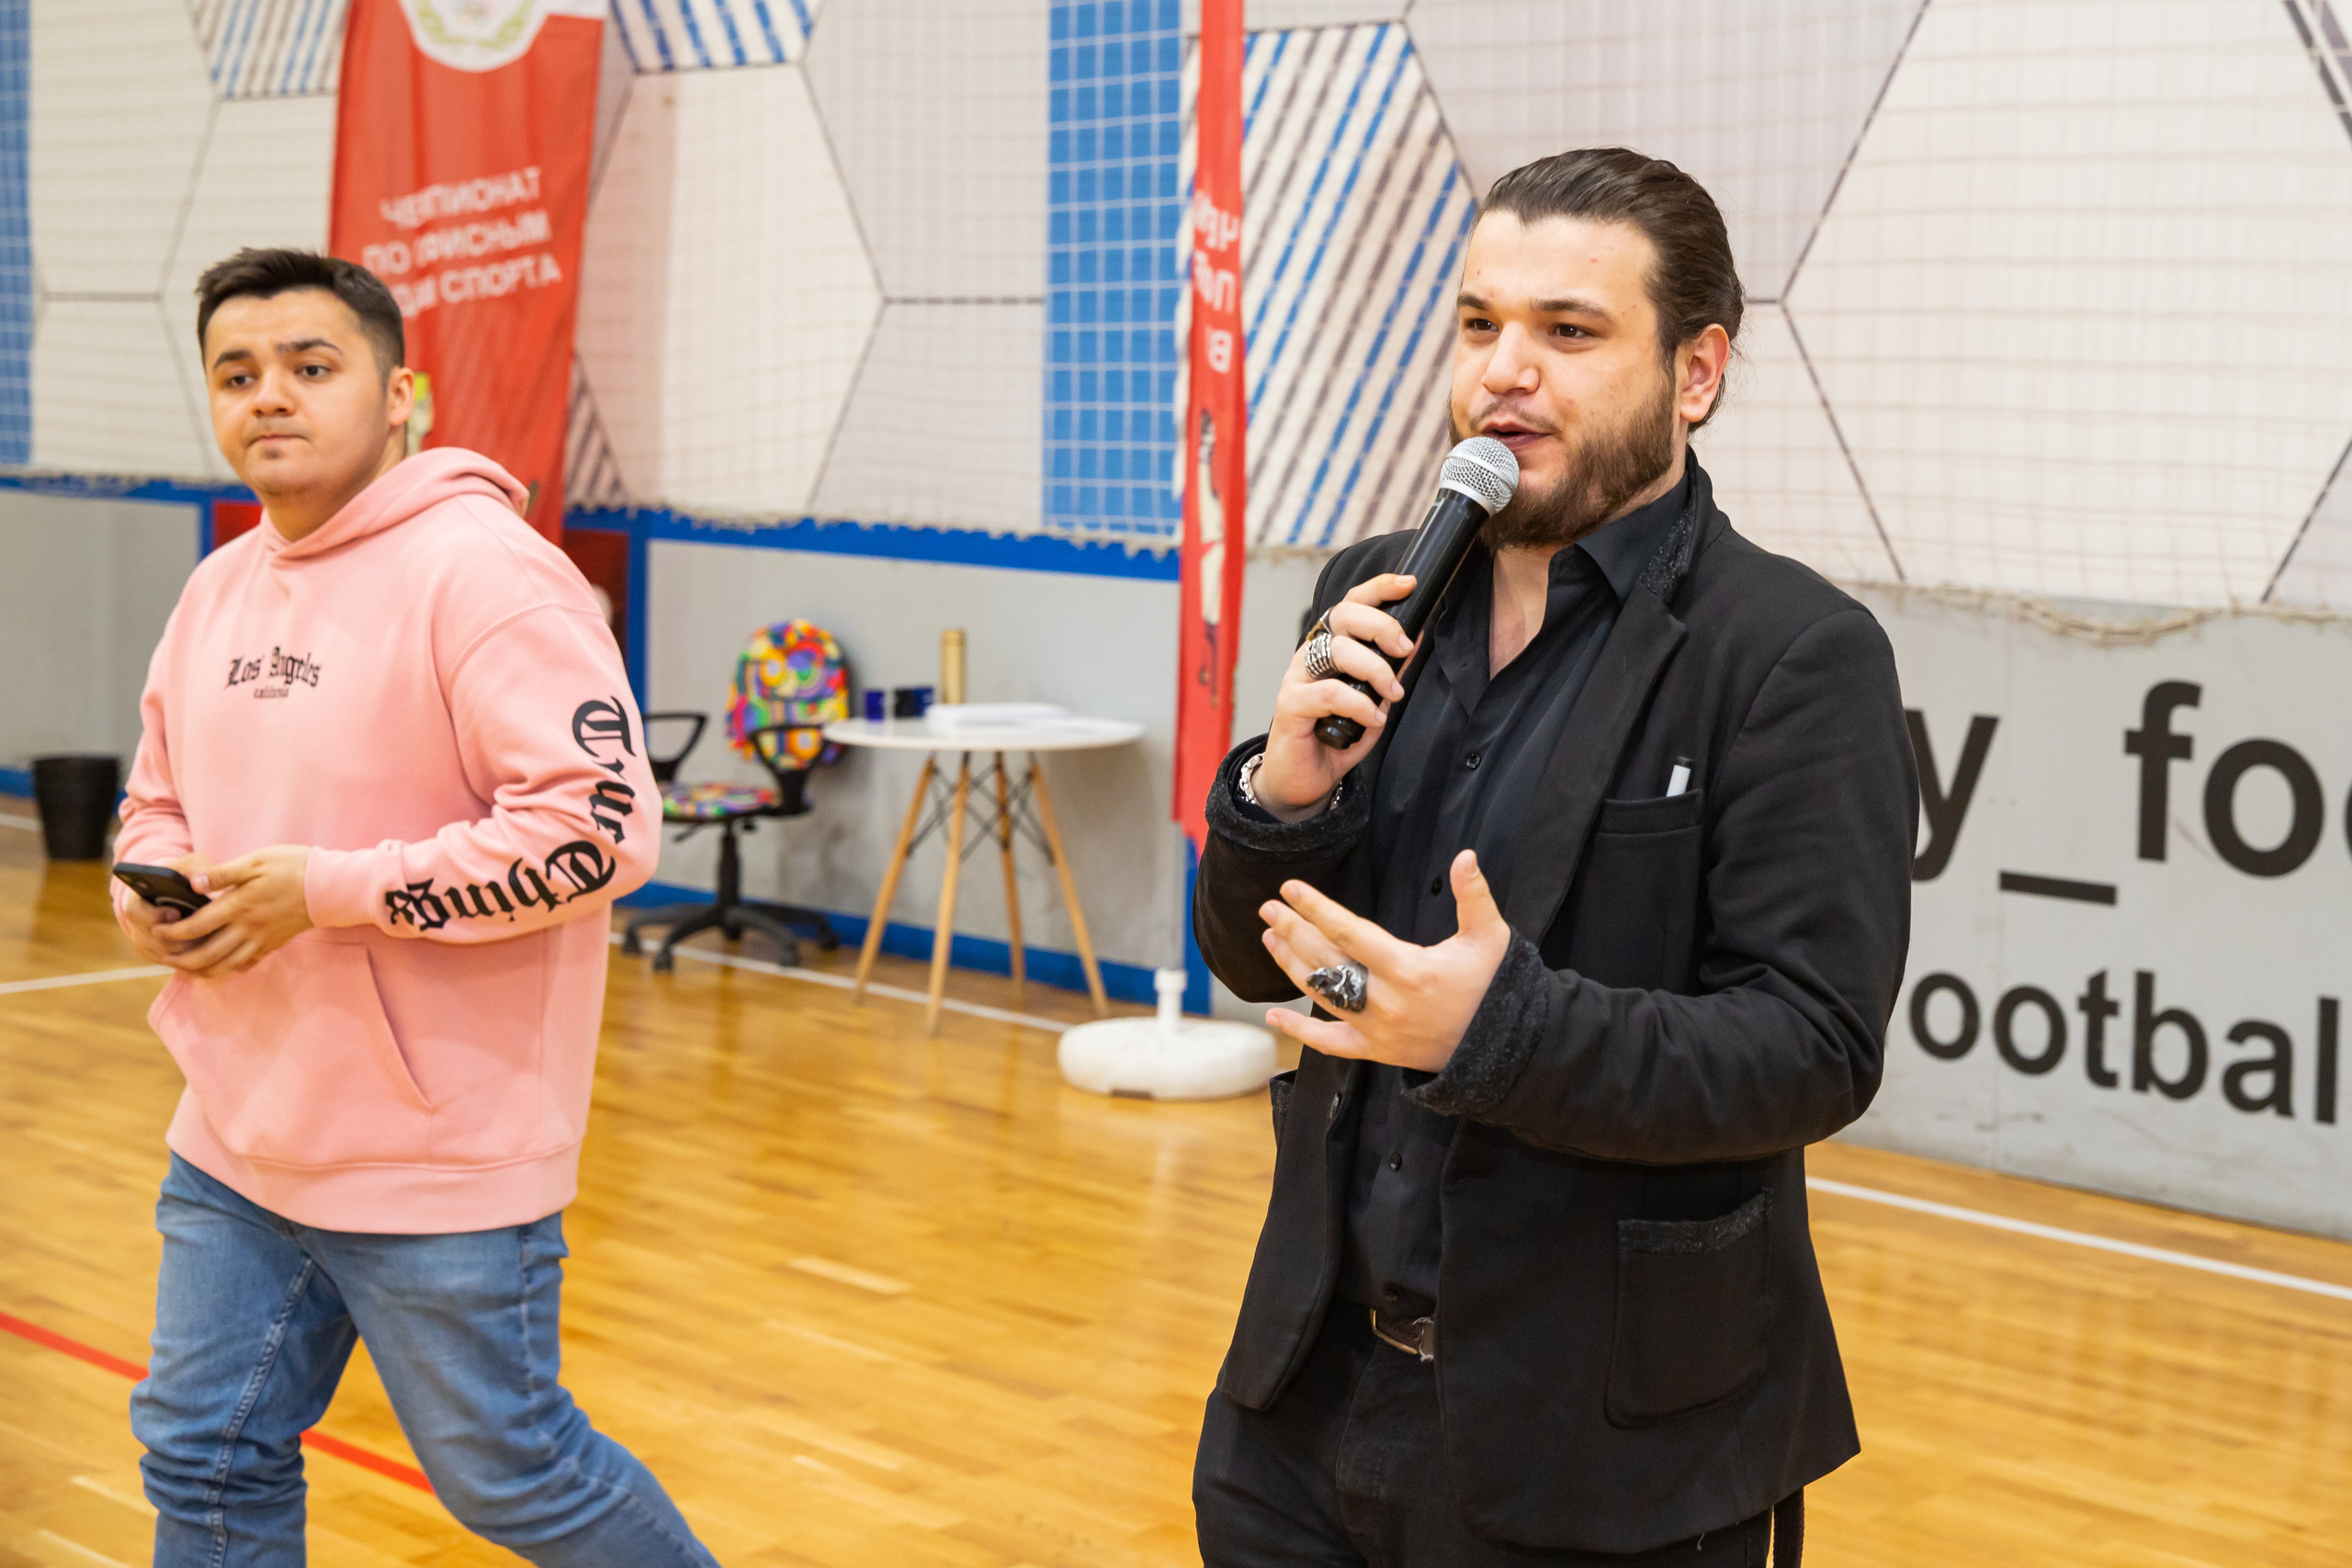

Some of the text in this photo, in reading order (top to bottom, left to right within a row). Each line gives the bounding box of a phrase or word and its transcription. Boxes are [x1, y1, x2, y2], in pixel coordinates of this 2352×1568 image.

[440, 253, 562, 303] СПОРТА
[224, 646, 322, 689] Los Angeles
[1905, 679, 2352, 908] y_fo
[385, 840, 616, 931] Things
[1885, 968, 2341, 1126] ootbal
